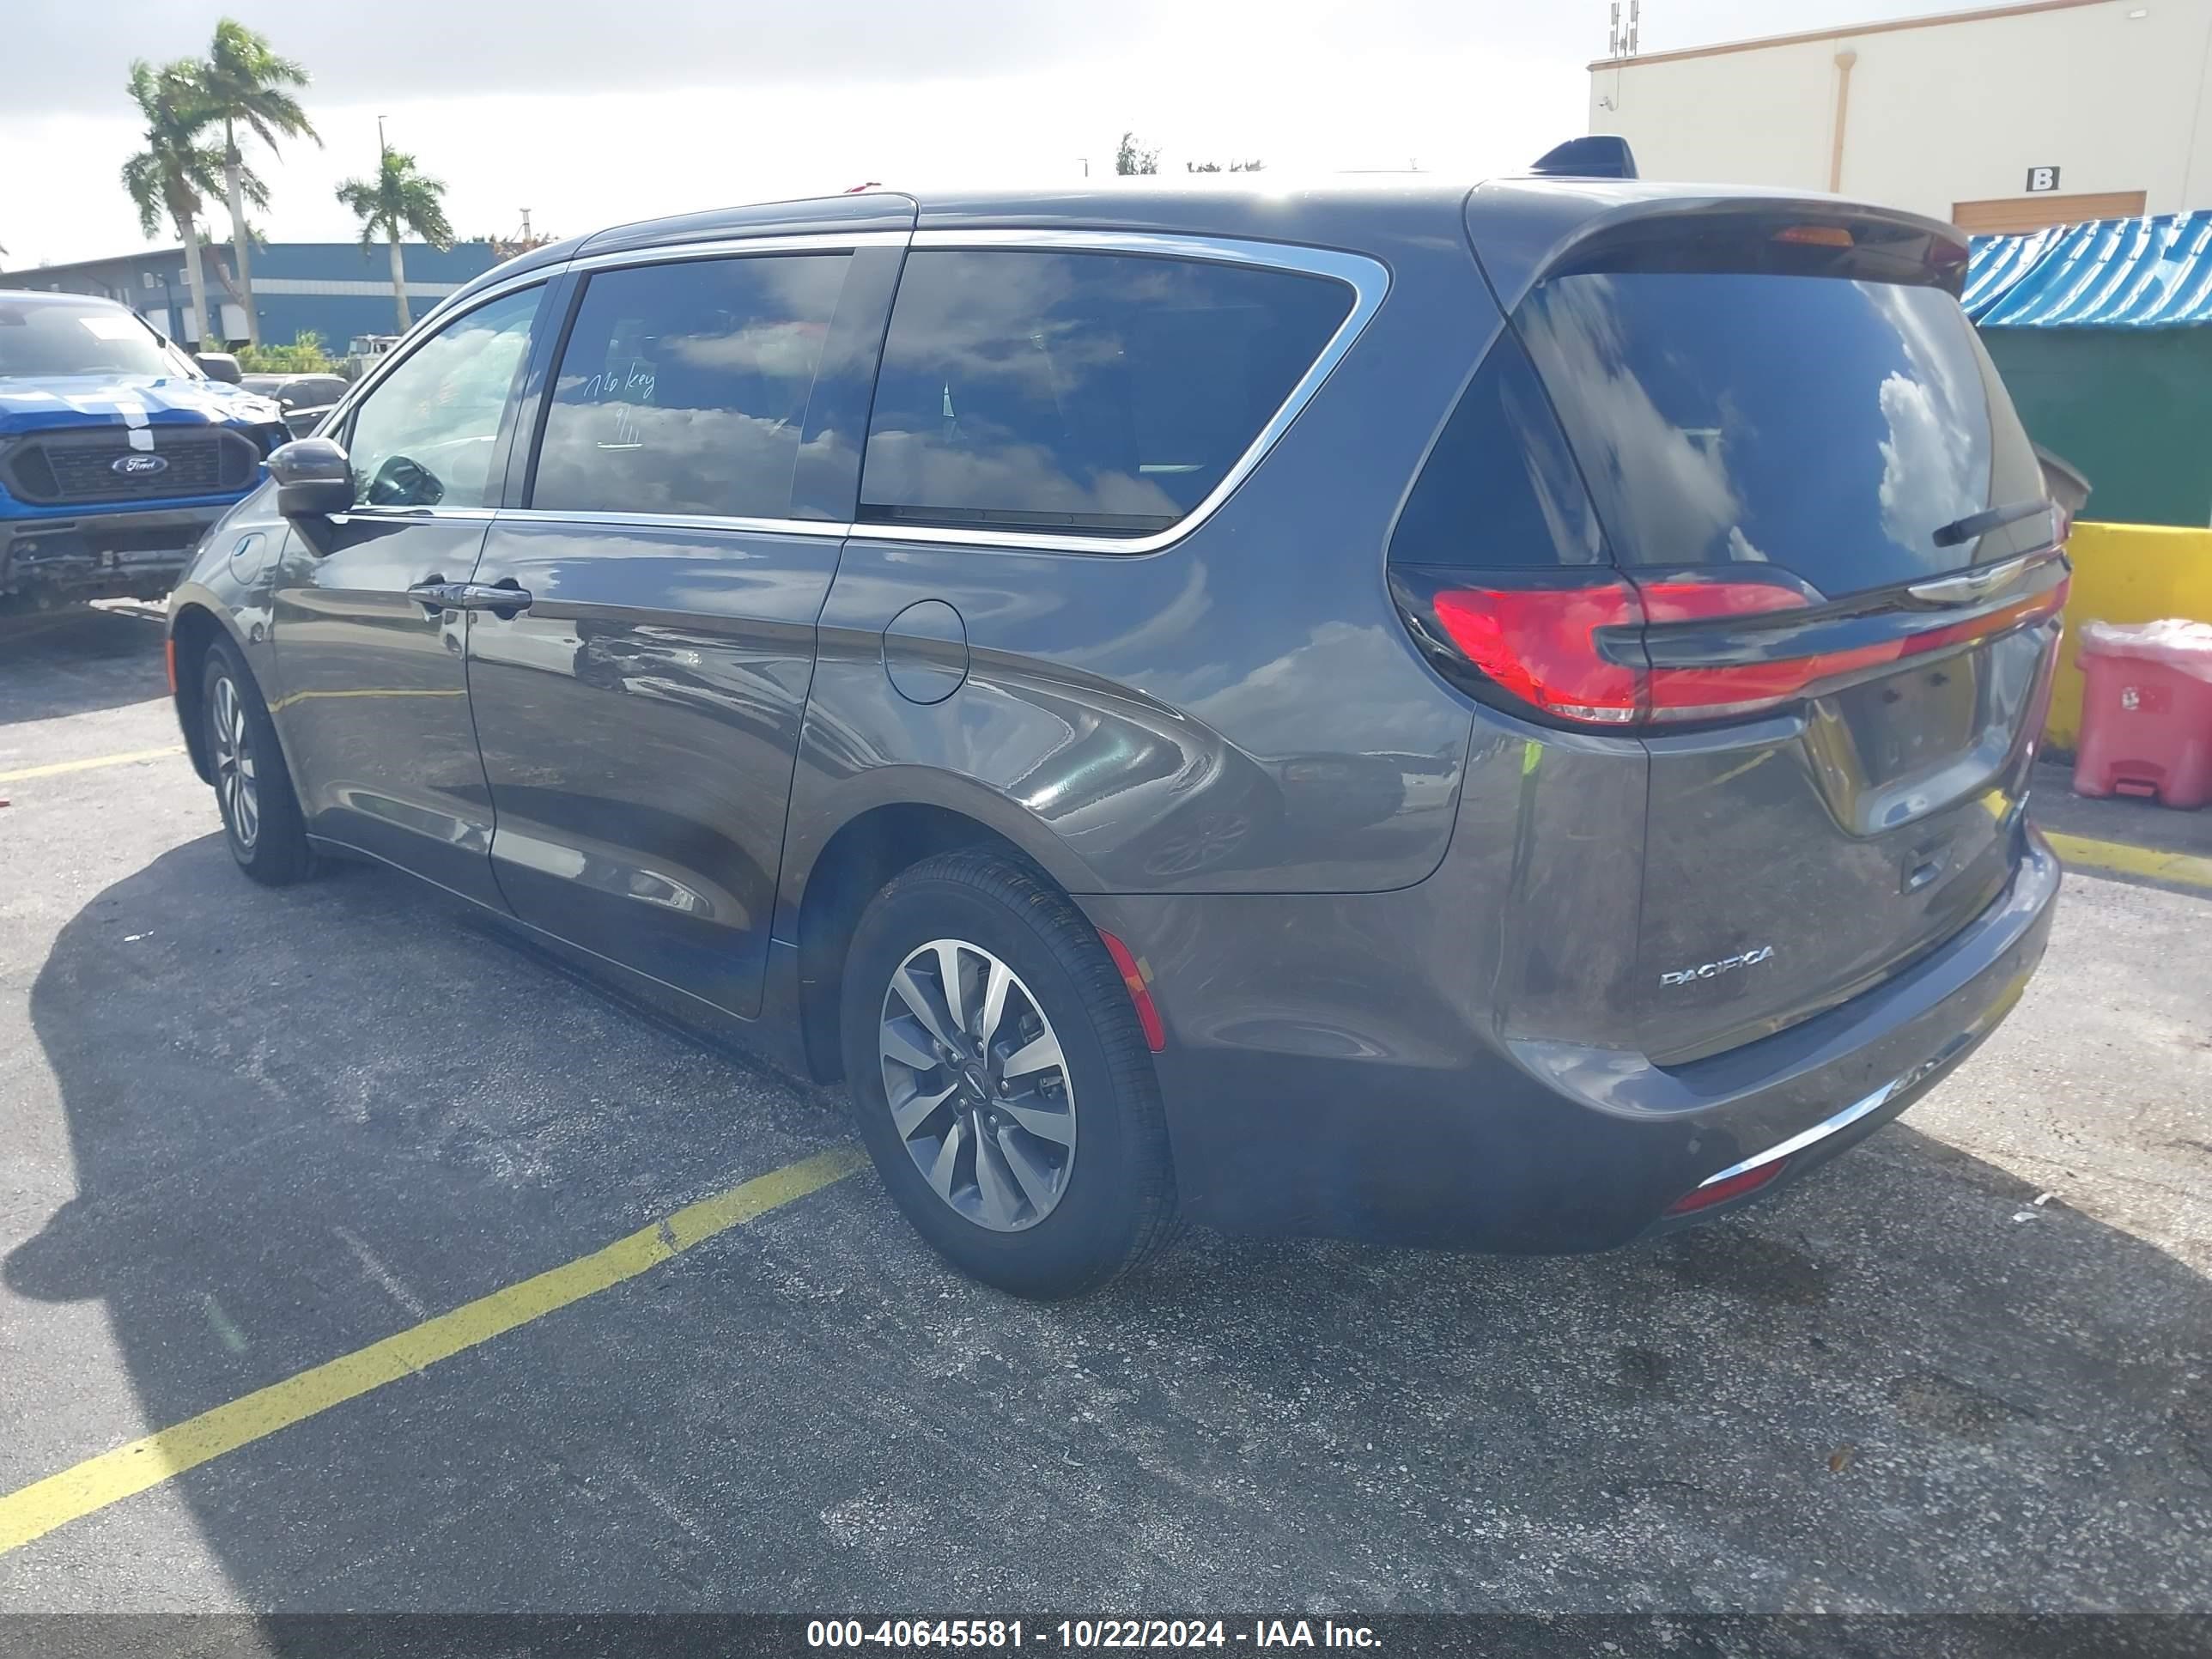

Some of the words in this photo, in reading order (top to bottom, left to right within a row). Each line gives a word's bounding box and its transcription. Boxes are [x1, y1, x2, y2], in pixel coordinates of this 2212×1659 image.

[2033, 167, 2053, 191] B
[624, 362, 656, 399] key
[126, 458, 156, 472] Ford
[1658, 945, 1774, 989] PACIFICA
